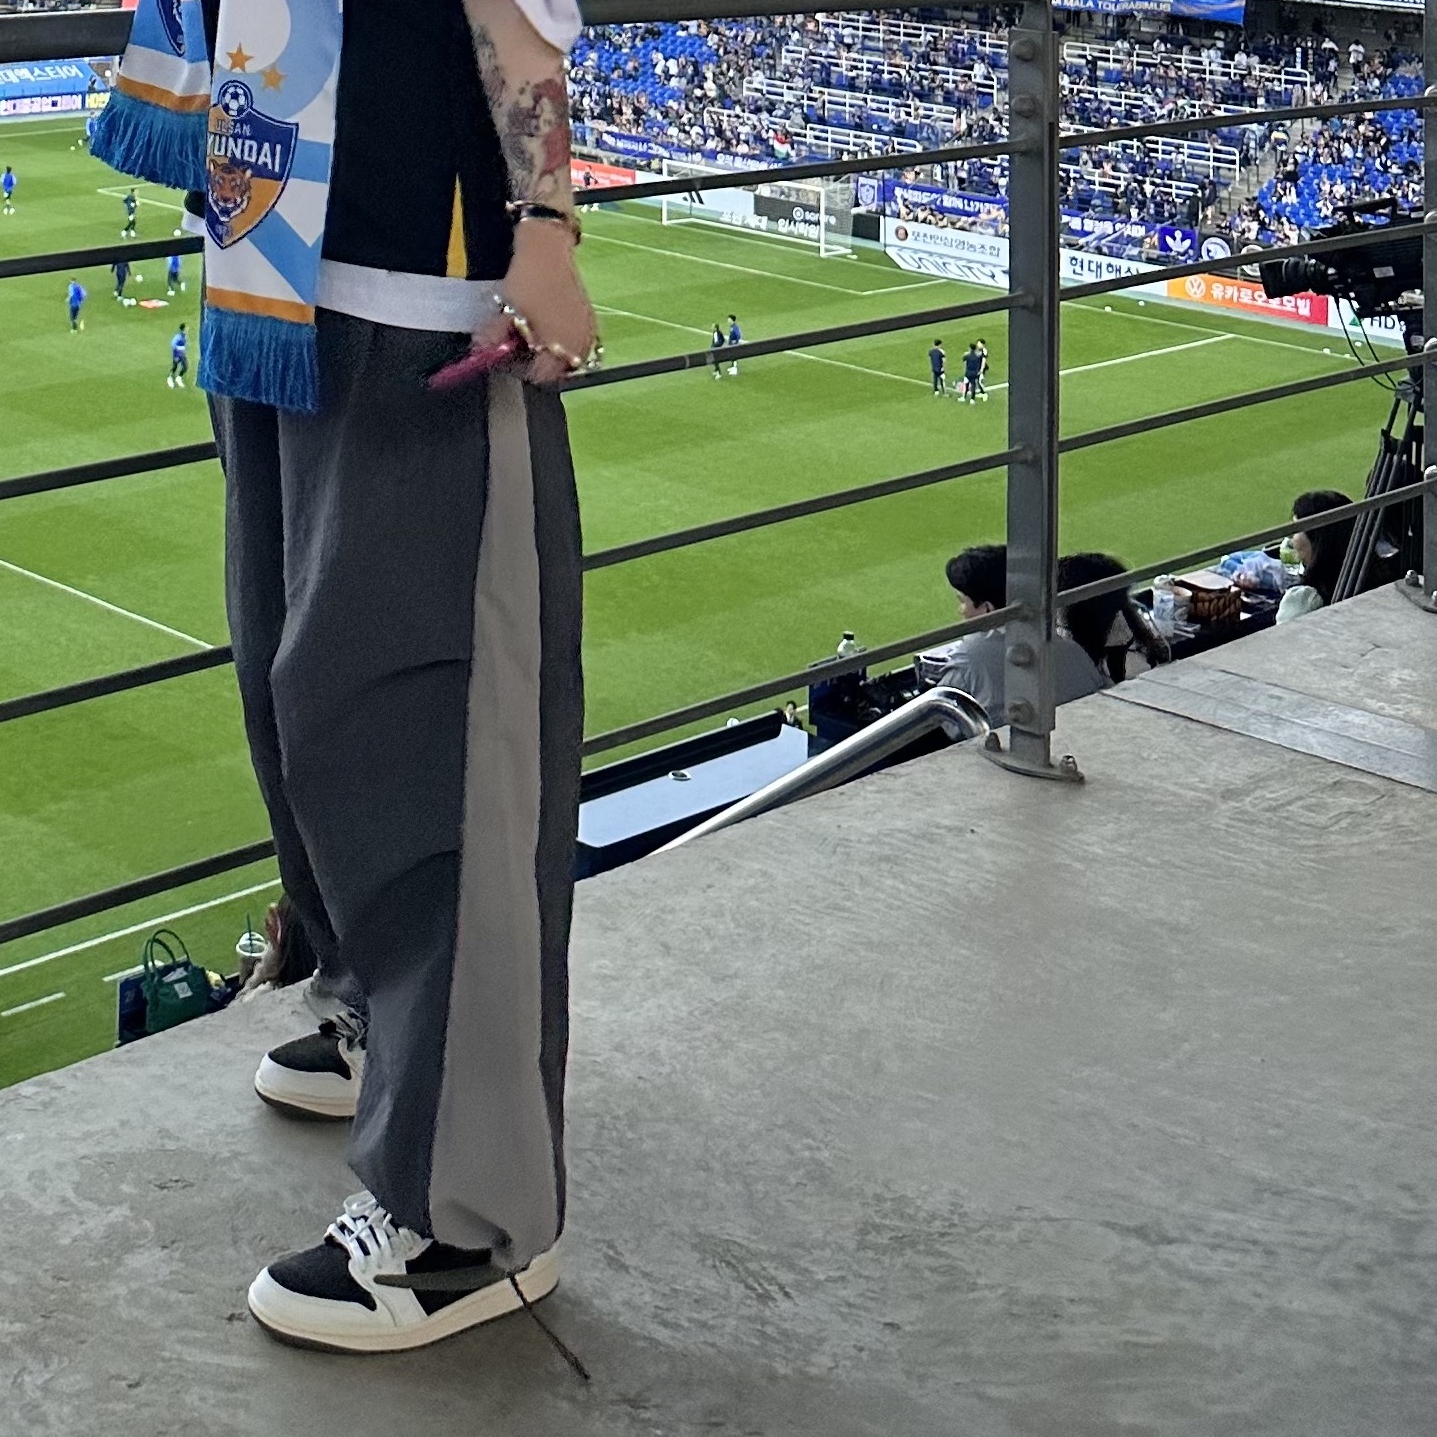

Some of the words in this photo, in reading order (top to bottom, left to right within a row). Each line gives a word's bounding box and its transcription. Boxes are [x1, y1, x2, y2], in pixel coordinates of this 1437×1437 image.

[215, 118, 252, 137] ULSAN
[206, 132, 282, 173] YUNDAI
[895, 251, 1000, 285] UNICITY
